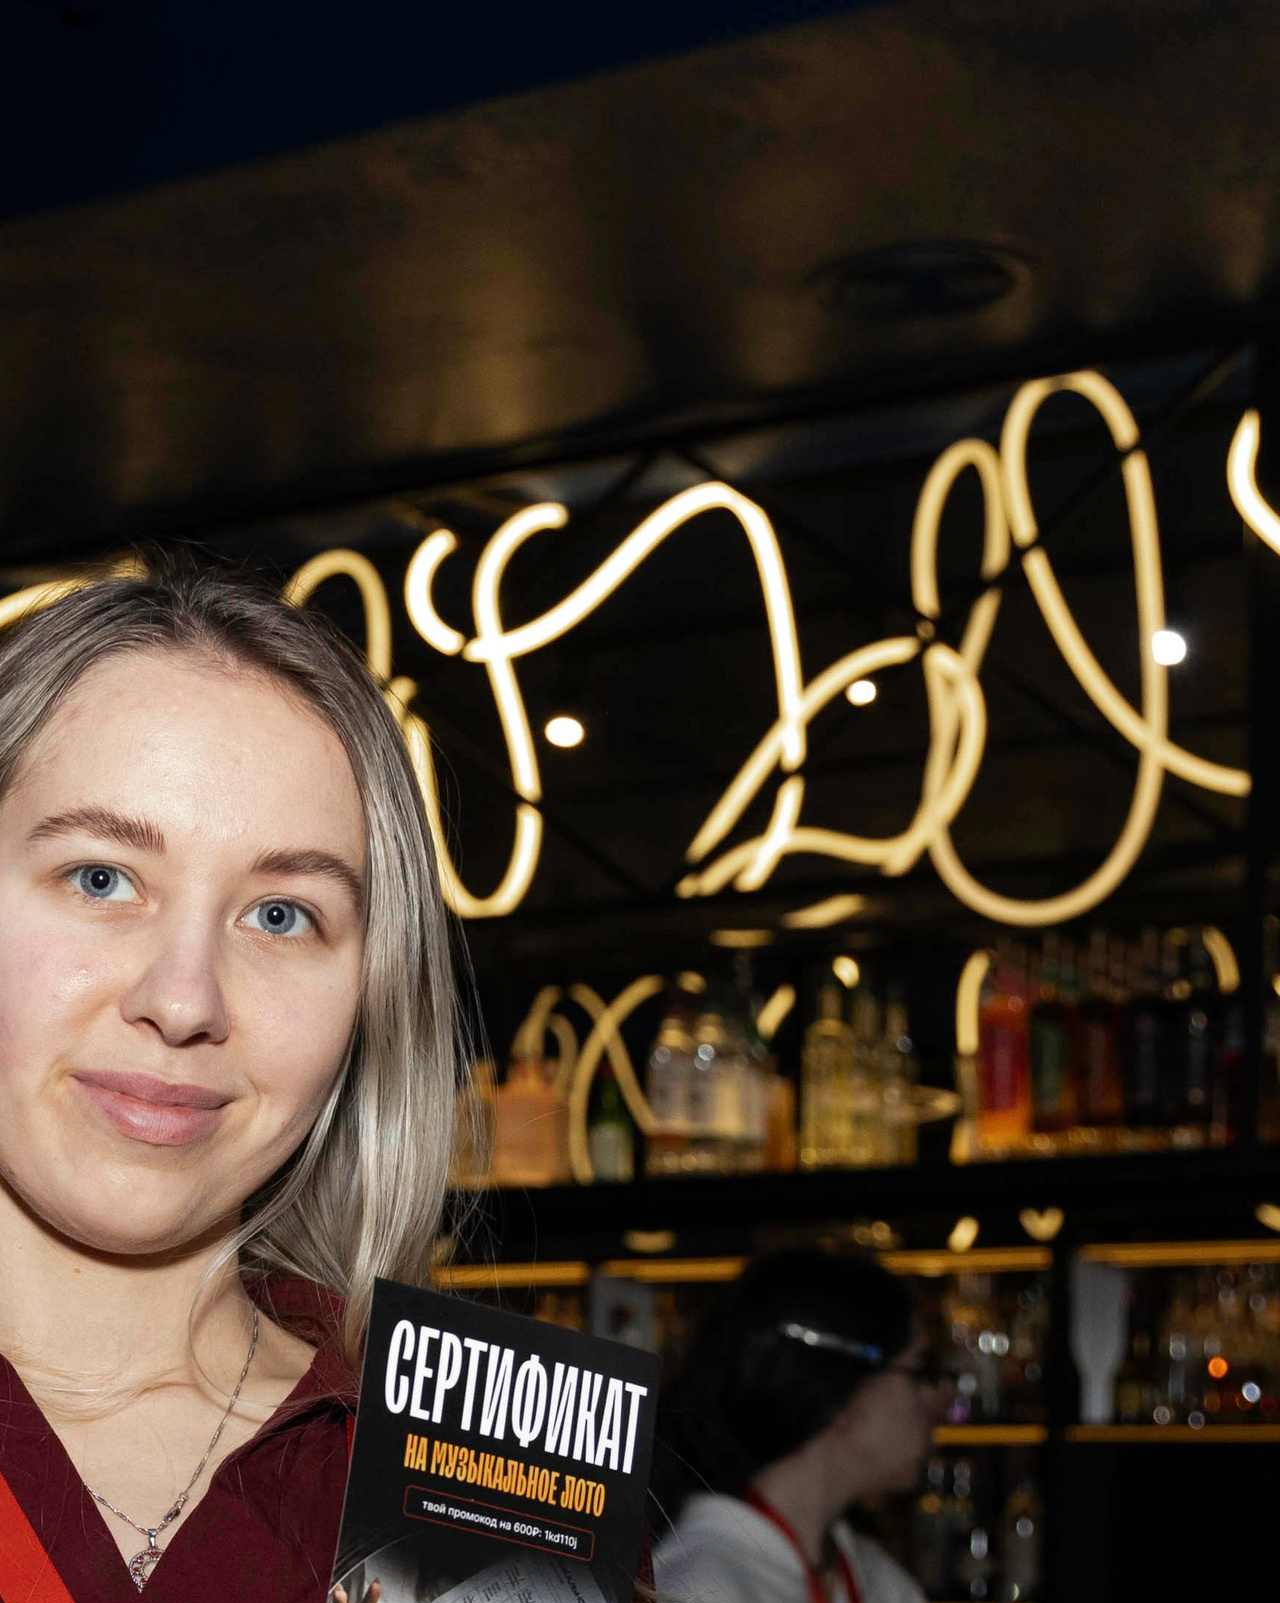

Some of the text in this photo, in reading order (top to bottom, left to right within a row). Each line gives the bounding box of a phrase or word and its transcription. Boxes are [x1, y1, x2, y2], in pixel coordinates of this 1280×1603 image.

[384, 1319, 648, 1475] СЕРТИФИКАТ
[404, 1433, 607, 1518] НА МУЗЫКАЛЬНОЕ ЛОТО
[422, 1500, 446, 1515] твой
[447, 1506, 498, 1529] промокод
[499, 1519, 512, 1532] на
[544, 1529, 578, 1550] 1kd110j
